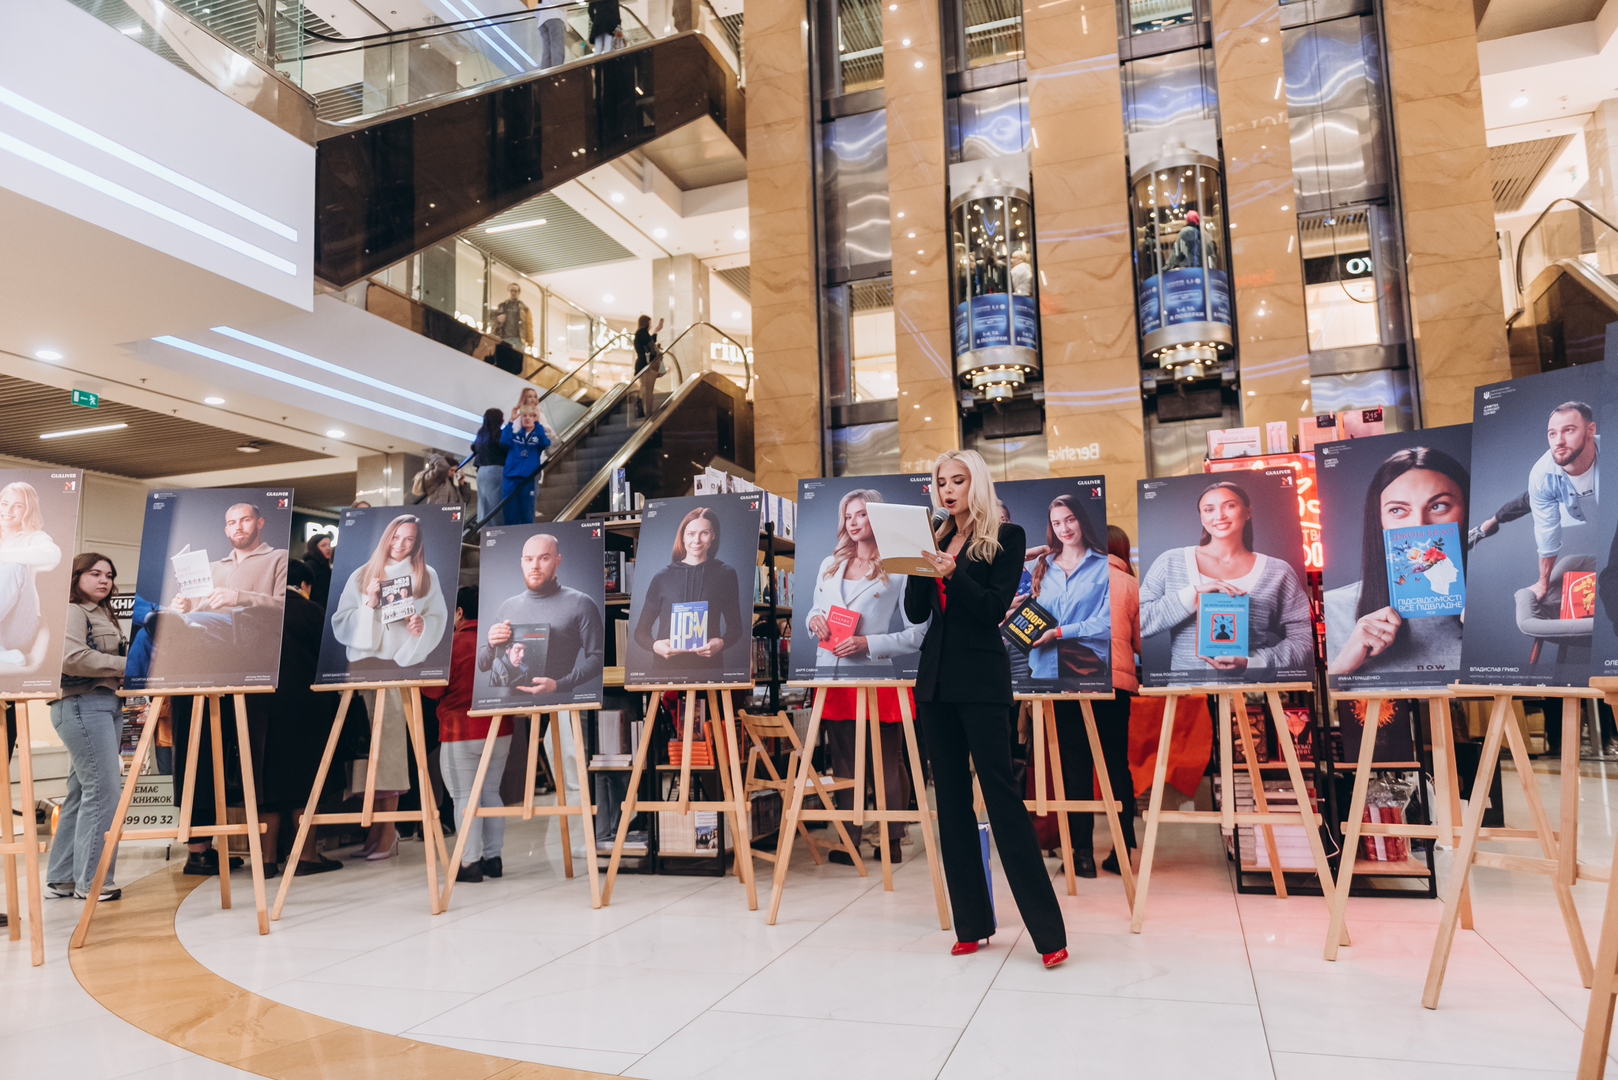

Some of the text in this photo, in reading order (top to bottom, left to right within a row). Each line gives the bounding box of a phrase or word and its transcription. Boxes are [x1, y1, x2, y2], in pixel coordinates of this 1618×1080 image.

[1392, 528, 1455, 541] ДЖОН КЕХО
[1398, 594, 1462, 605] ПІДСВІДОМОСТІ
[1416, 601, 1463, 611] ПІДВЛАДНЕ
[1021, 607, 1047, 630] СПОРТ
[1012, 614, 1038, 639] ПОЗА
[143, 815, 157, 824] 09
[160, 815, 173, 824] 32
